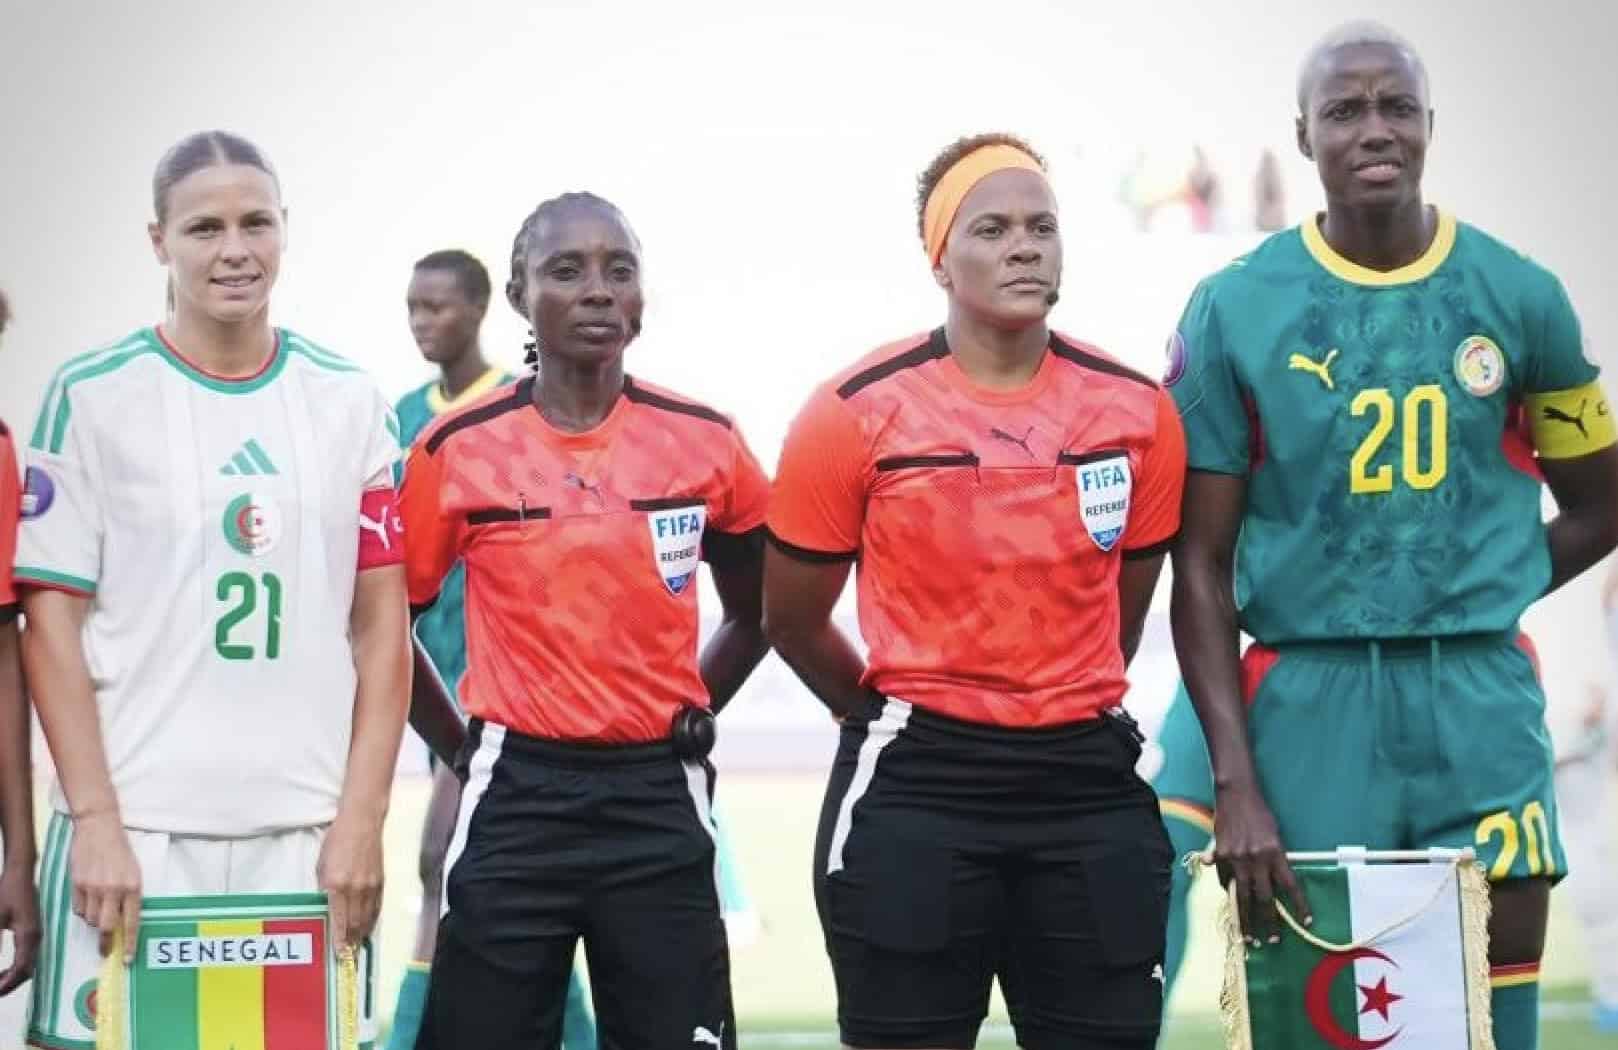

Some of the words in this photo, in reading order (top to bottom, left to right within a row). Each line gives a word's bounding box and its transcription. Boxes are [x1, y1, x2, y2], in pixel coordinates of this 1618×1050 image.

[1350, 385, 1447, 493] 20
[1082, 465, 1126, 491] FIFA
[656, 513, 699, 537] FIFA
[215, 571, 282, 660] 21
[157, 938, 300, 964] SENEGAL
